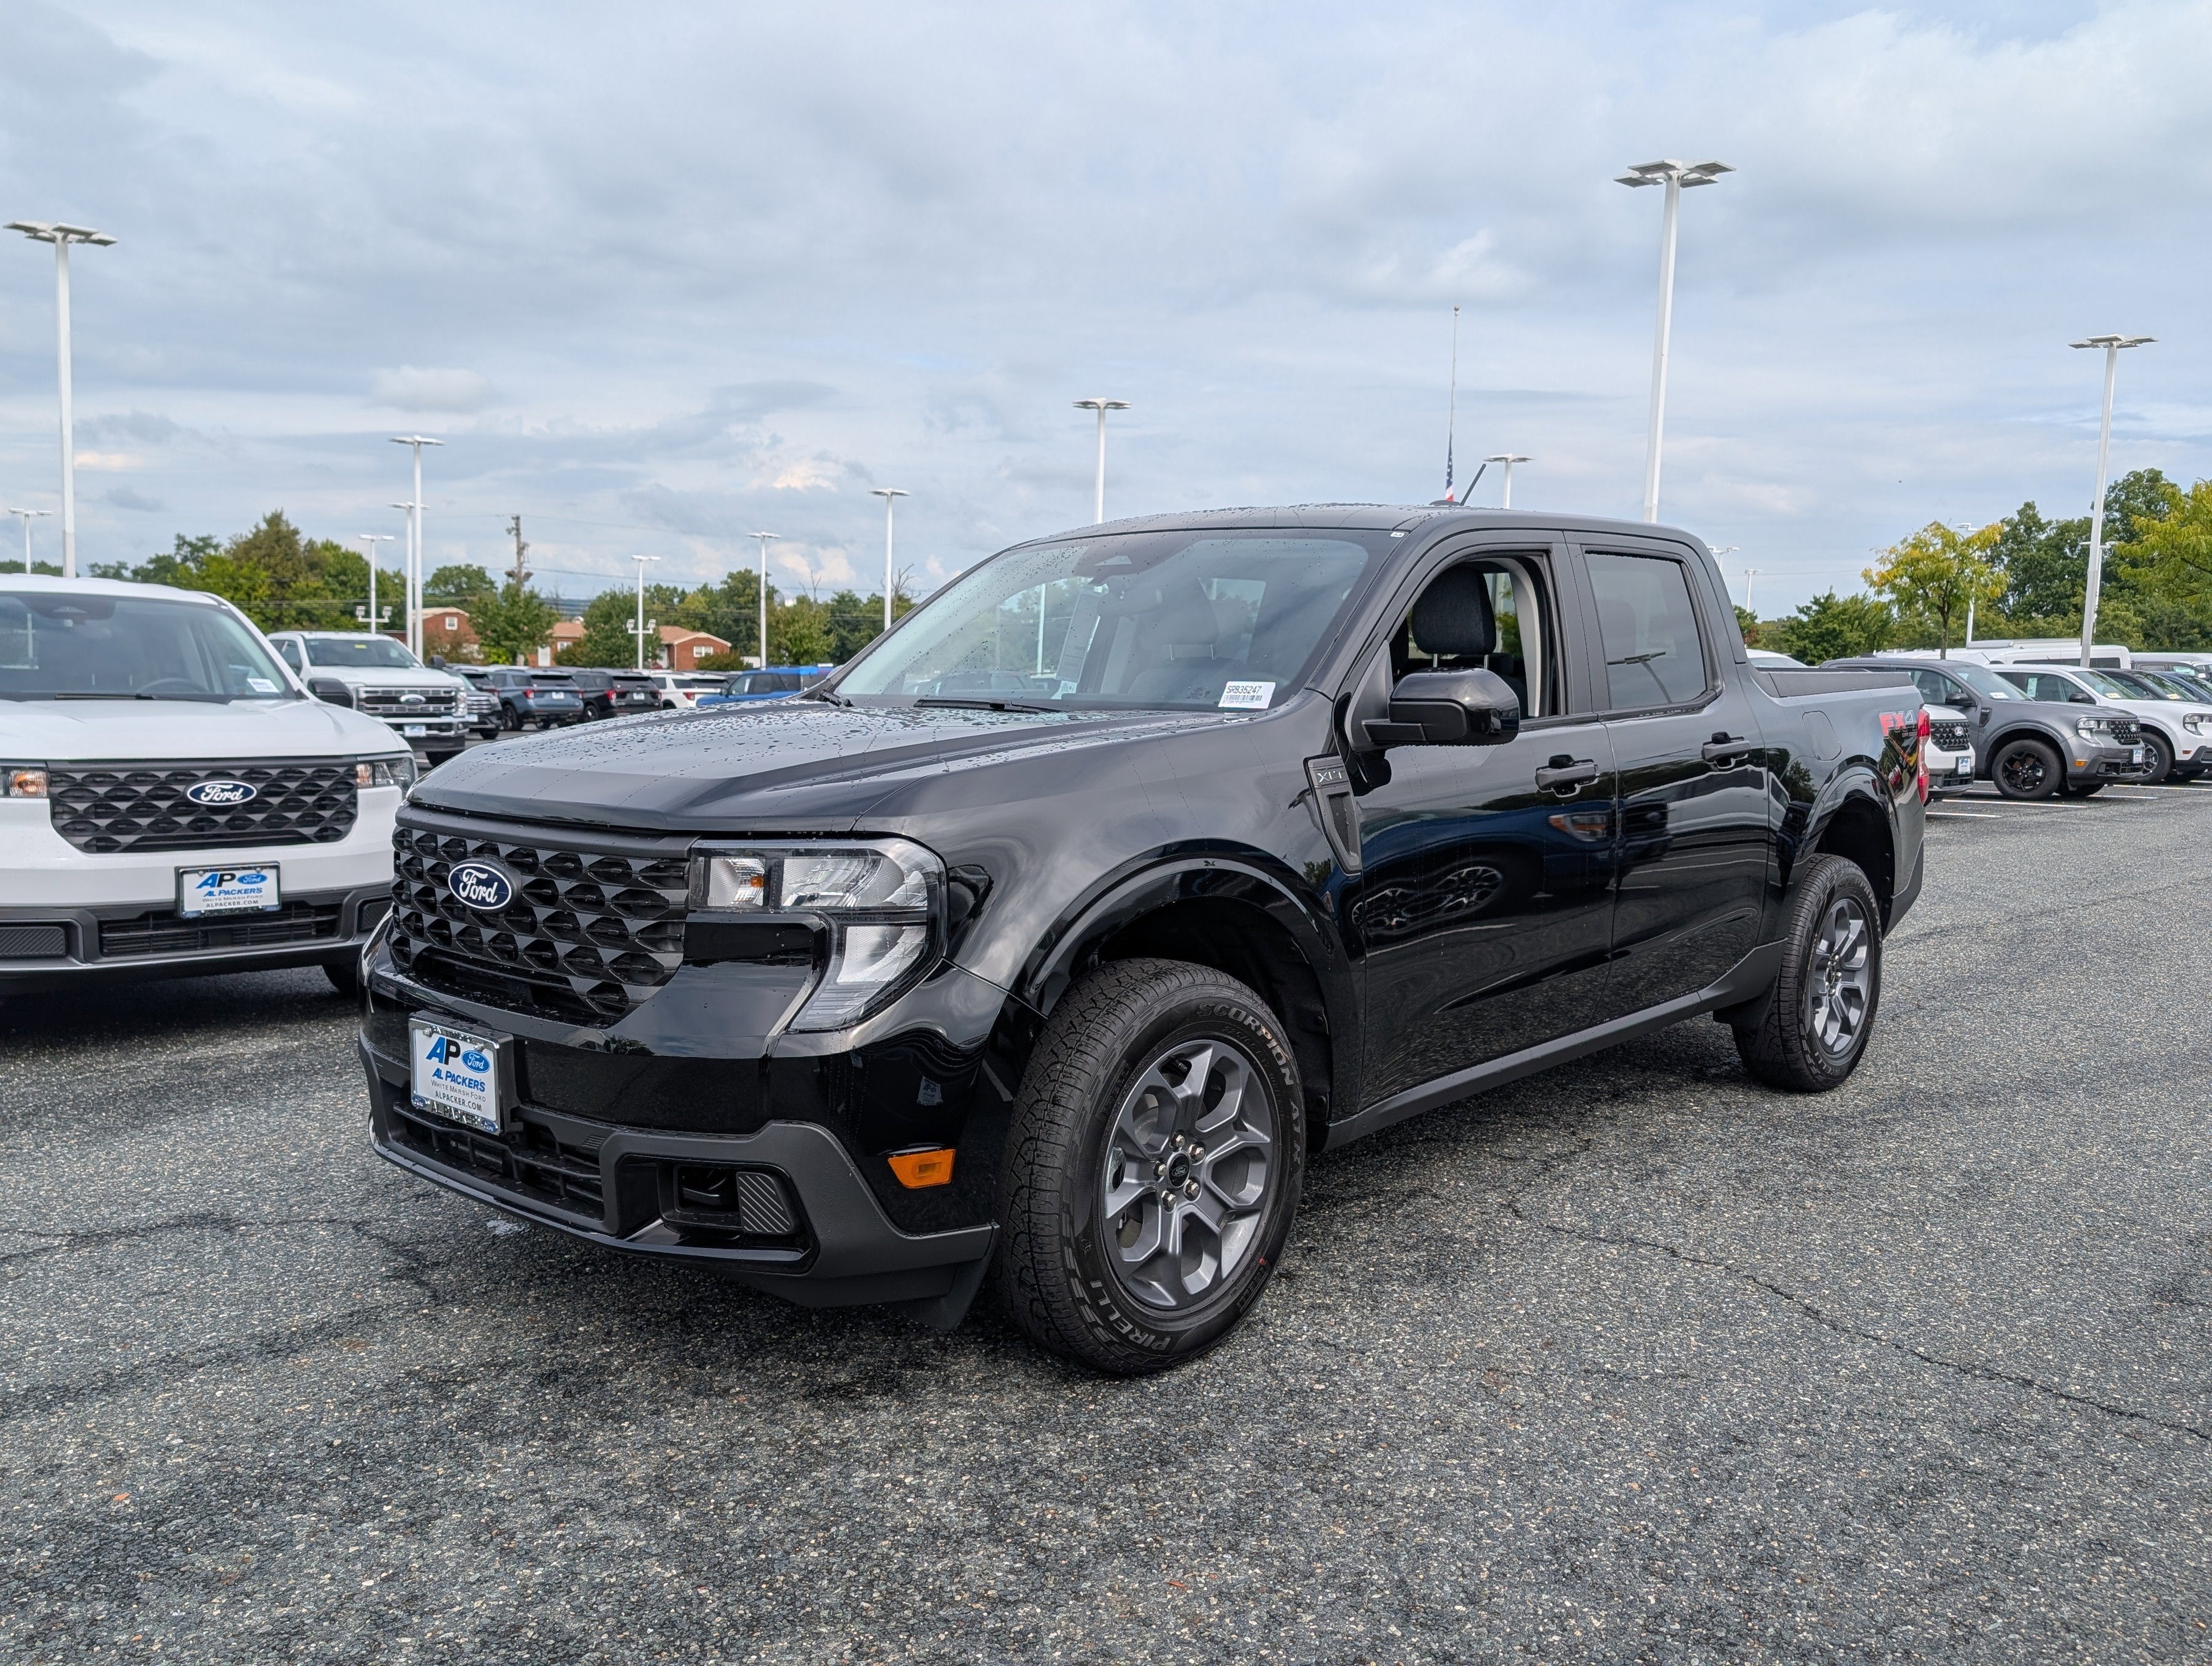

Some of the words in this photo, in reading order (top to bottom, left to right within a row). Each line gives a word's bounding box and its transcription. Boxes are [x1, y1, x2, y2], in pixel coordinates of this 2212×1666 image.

[1879, 710, 1918, 737] FX4
[1316, 771, 1342, 783] XLT
[201, 784, 244, 801] Ford
[195, 873, 236, 889] AP
[243, 874, 261, 883] Ford
[459, 869, 498, 904] Ford
[218, 887, 263, 896] PACKER'S
[206, 900, 259, 908] ALPACKER.COM
[426, 1036, 461, 1066] AP
[1197, 1003, 1295, 1085] SCORPION
[467, 1053, 485, 1069] Ford
[431, 1079, 448, 1091] WHITE
[449, 1085, 470, 1097] MARSH
[471, 1092, 486, 1102] FORD
[432, 1068, 443, 1080] AL
[445, 1071, 486, 1092] PACKER'S
[435, 1091, 482, 1112] ALPACKER.COM
[1090, 1280, 1171, 1350] PIRELLI
